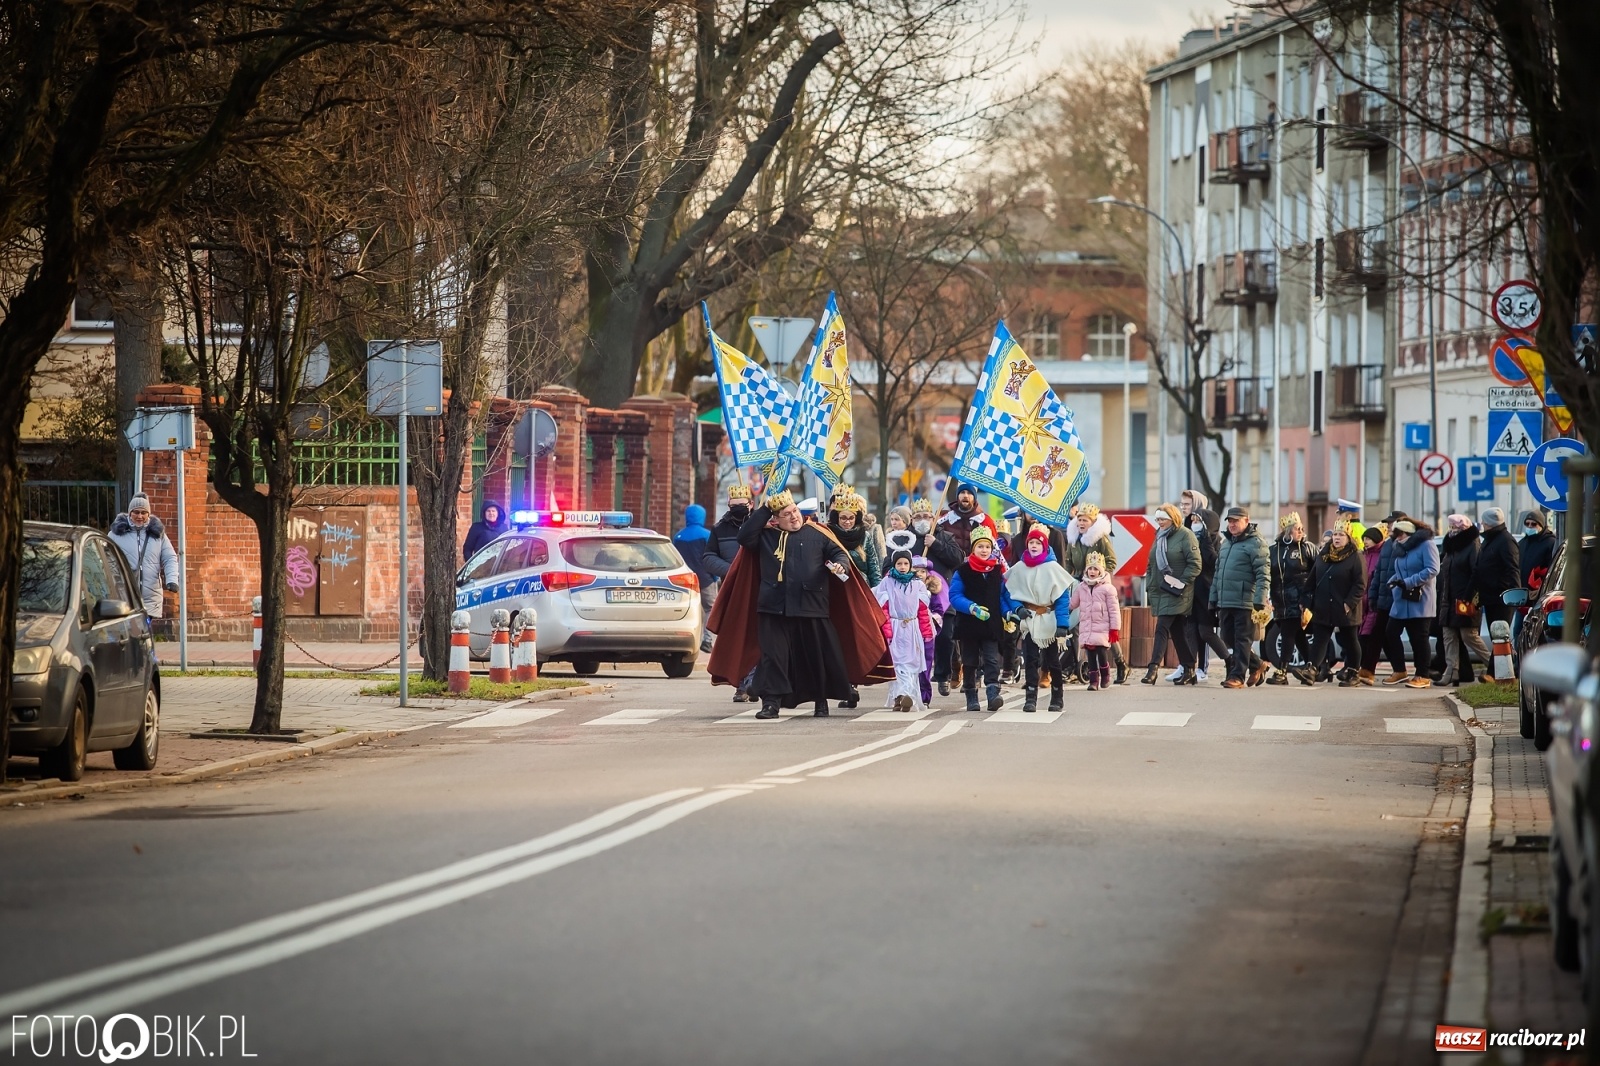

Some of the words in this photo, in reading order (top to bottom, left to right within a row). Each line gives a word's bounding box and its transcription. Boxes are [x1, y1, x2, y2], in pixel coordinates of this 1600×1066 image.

[1412, 428, 1423, 444] L
[1465, 460, 1487, 489] P
[565, 513, 600, 523] POLICJA
[529, 581, 542, 592] P103
[612, 591, 632, 601] HPP
[634, 590, 656, 600] R029
[658, 592, 676, 601] P103
